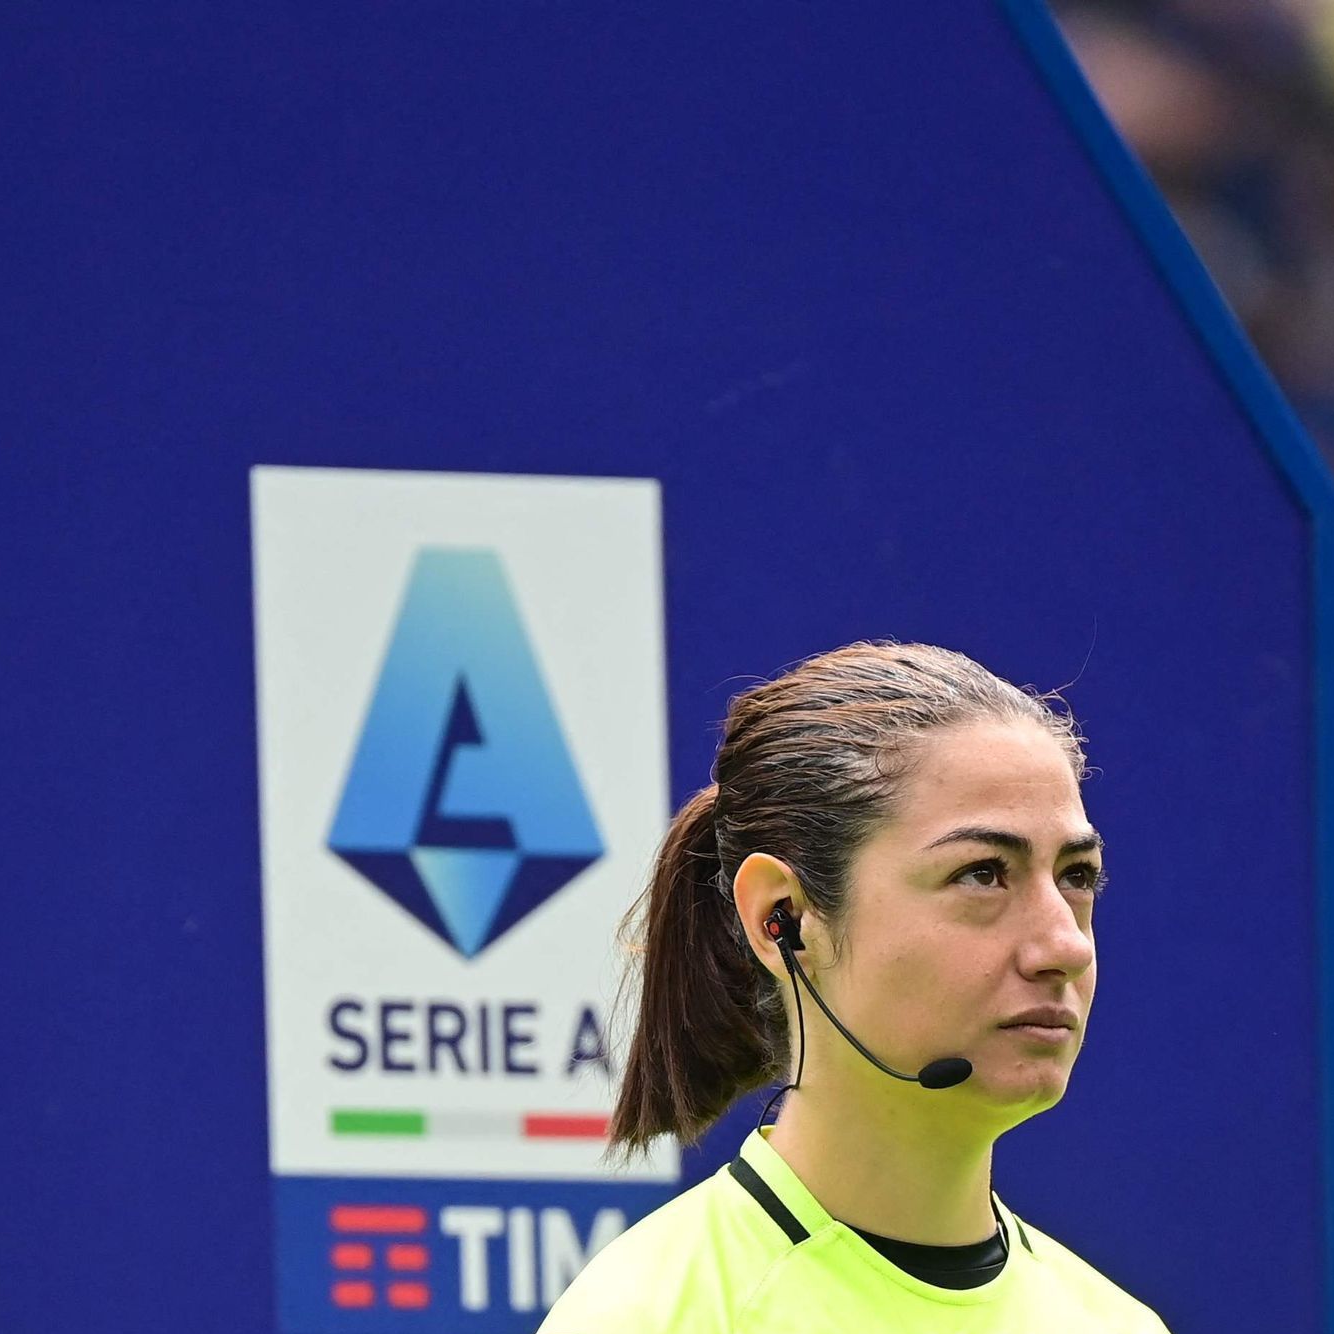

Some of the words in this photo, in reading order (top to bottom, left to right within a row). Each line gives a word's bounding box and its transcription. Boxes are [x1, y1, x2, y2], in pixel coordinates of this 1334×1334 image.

[329, 1000, 539, 1076] SERIE
[566, 1006, 612, 1077] A
[439, 1205, 628, 1312] TIM
